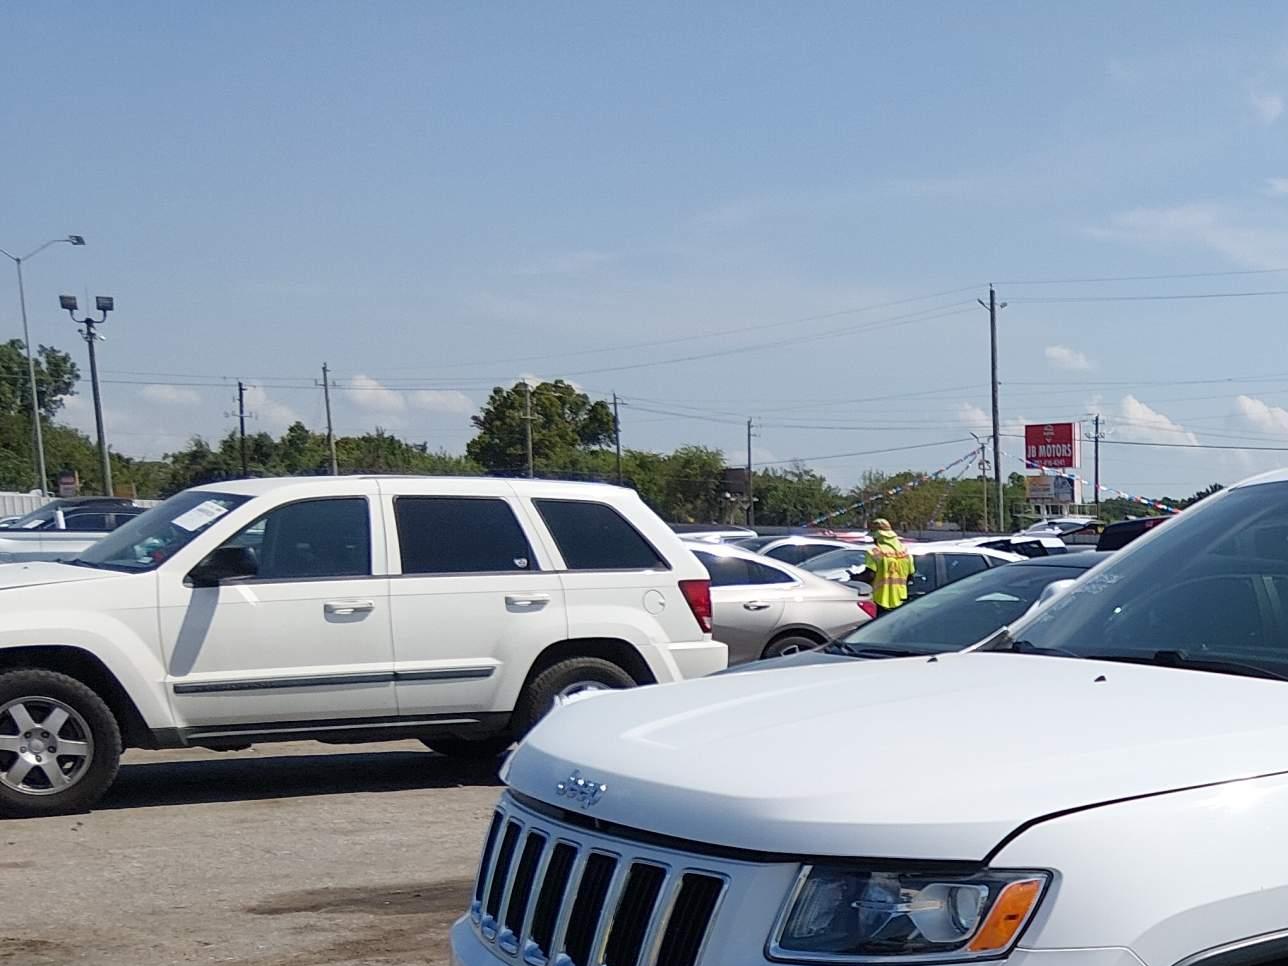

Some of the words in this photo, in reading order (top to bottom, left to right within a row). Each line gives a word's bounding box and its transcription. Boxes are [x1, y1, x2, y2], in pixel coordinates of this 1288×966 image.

[1027, 445, 1037, 458] JB
[1039, 443, 1072, 457] MOTORS
[556, 769, 608, 809] Jeep
